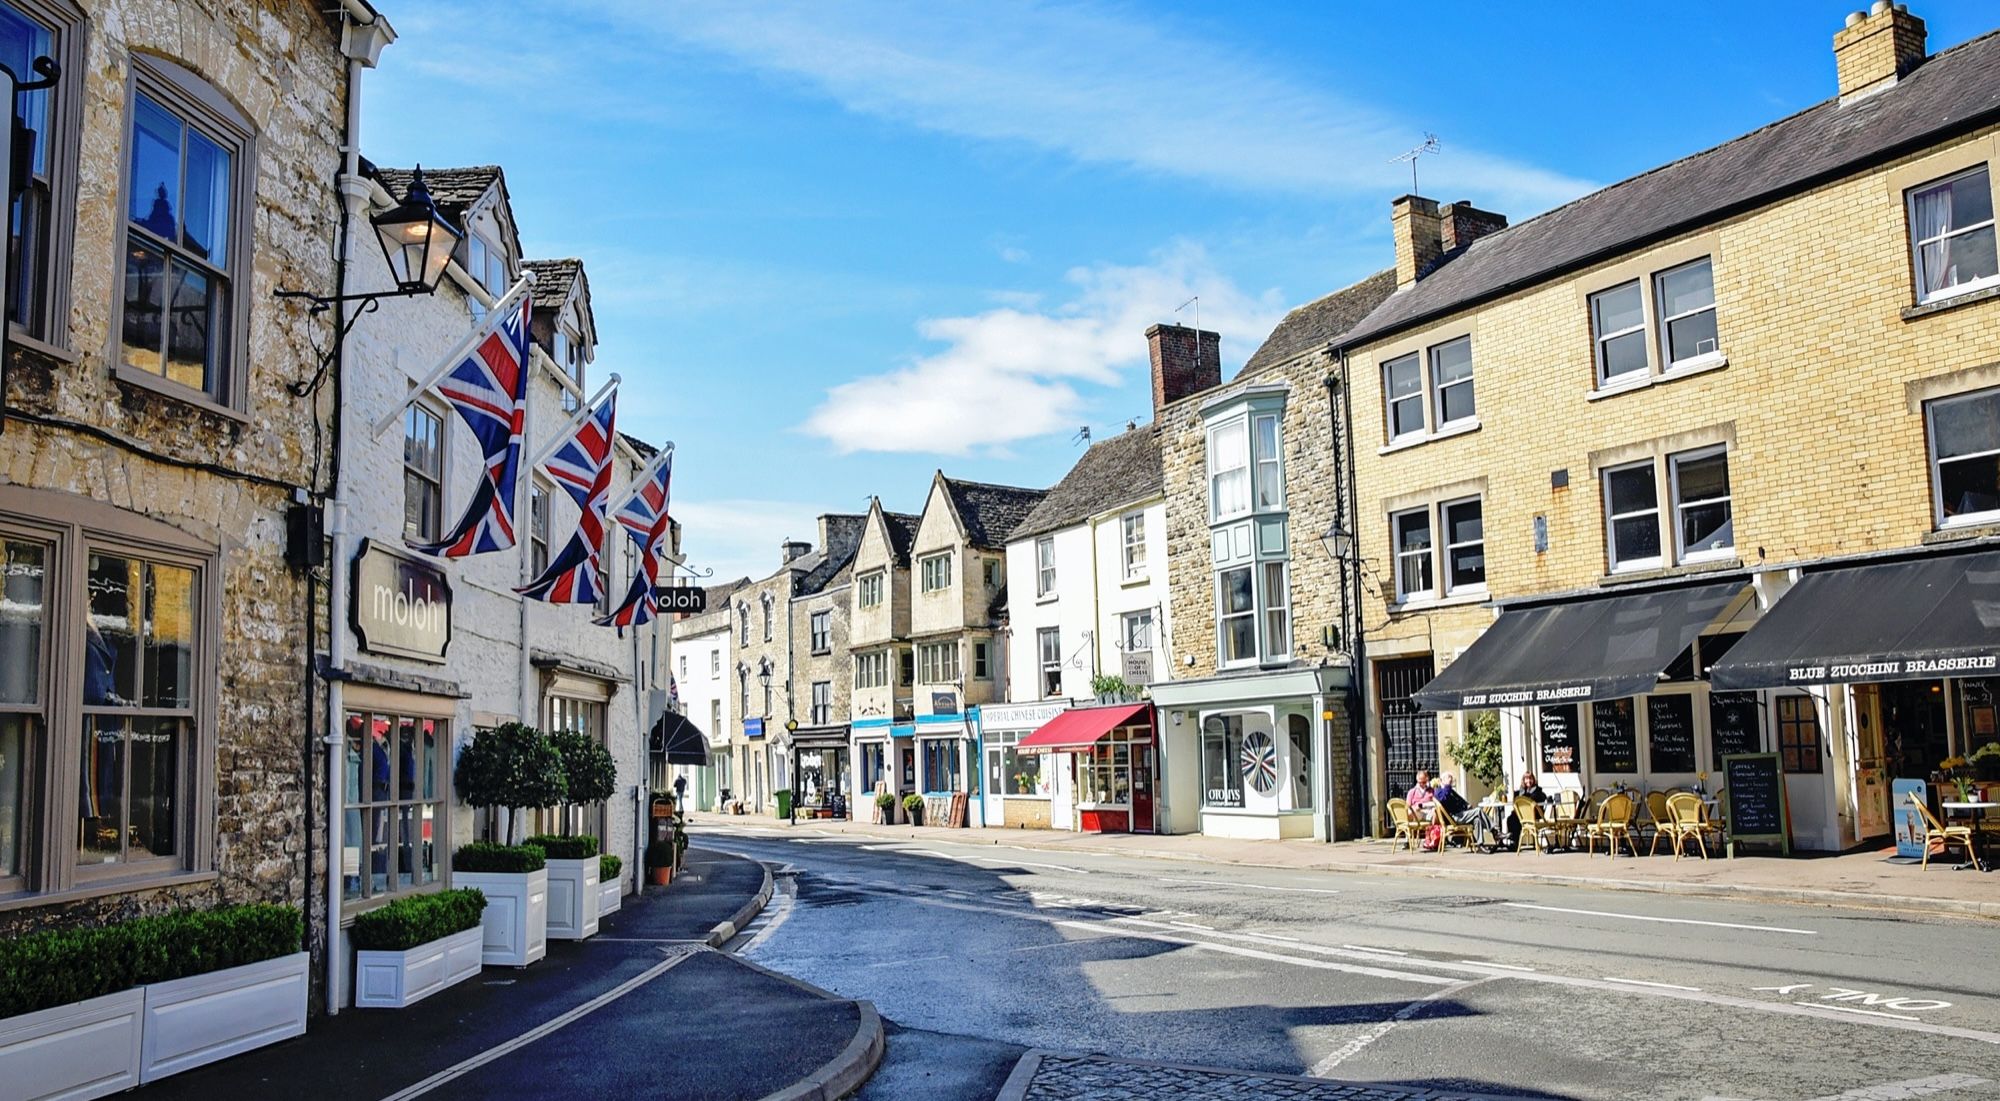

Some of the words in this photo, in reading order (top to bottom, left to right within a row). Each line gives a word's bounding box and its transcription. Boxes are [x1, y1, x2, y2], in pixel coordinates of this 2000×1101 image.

[374, 577, 437, 633] moloh
[656, 590, 700, 607] oloh
[1789, 667, 1825, 680] BLUE
[1830, 662, 1899, 678] ZUCCHINI
[1905, 656, 1996, 673] BRASSERIE
[1463, 696, 1486, 706] BLUE
[1489, 691, 1533, 703] ZUCCHINI
[1536, 686, 1591, 699] BRASSERIE
[984, 712, 1009, 722] IMPERIAL
[1010, 709, 1036, 721] CHINESE
[1752, 984, 1952, 1010] ONLY
